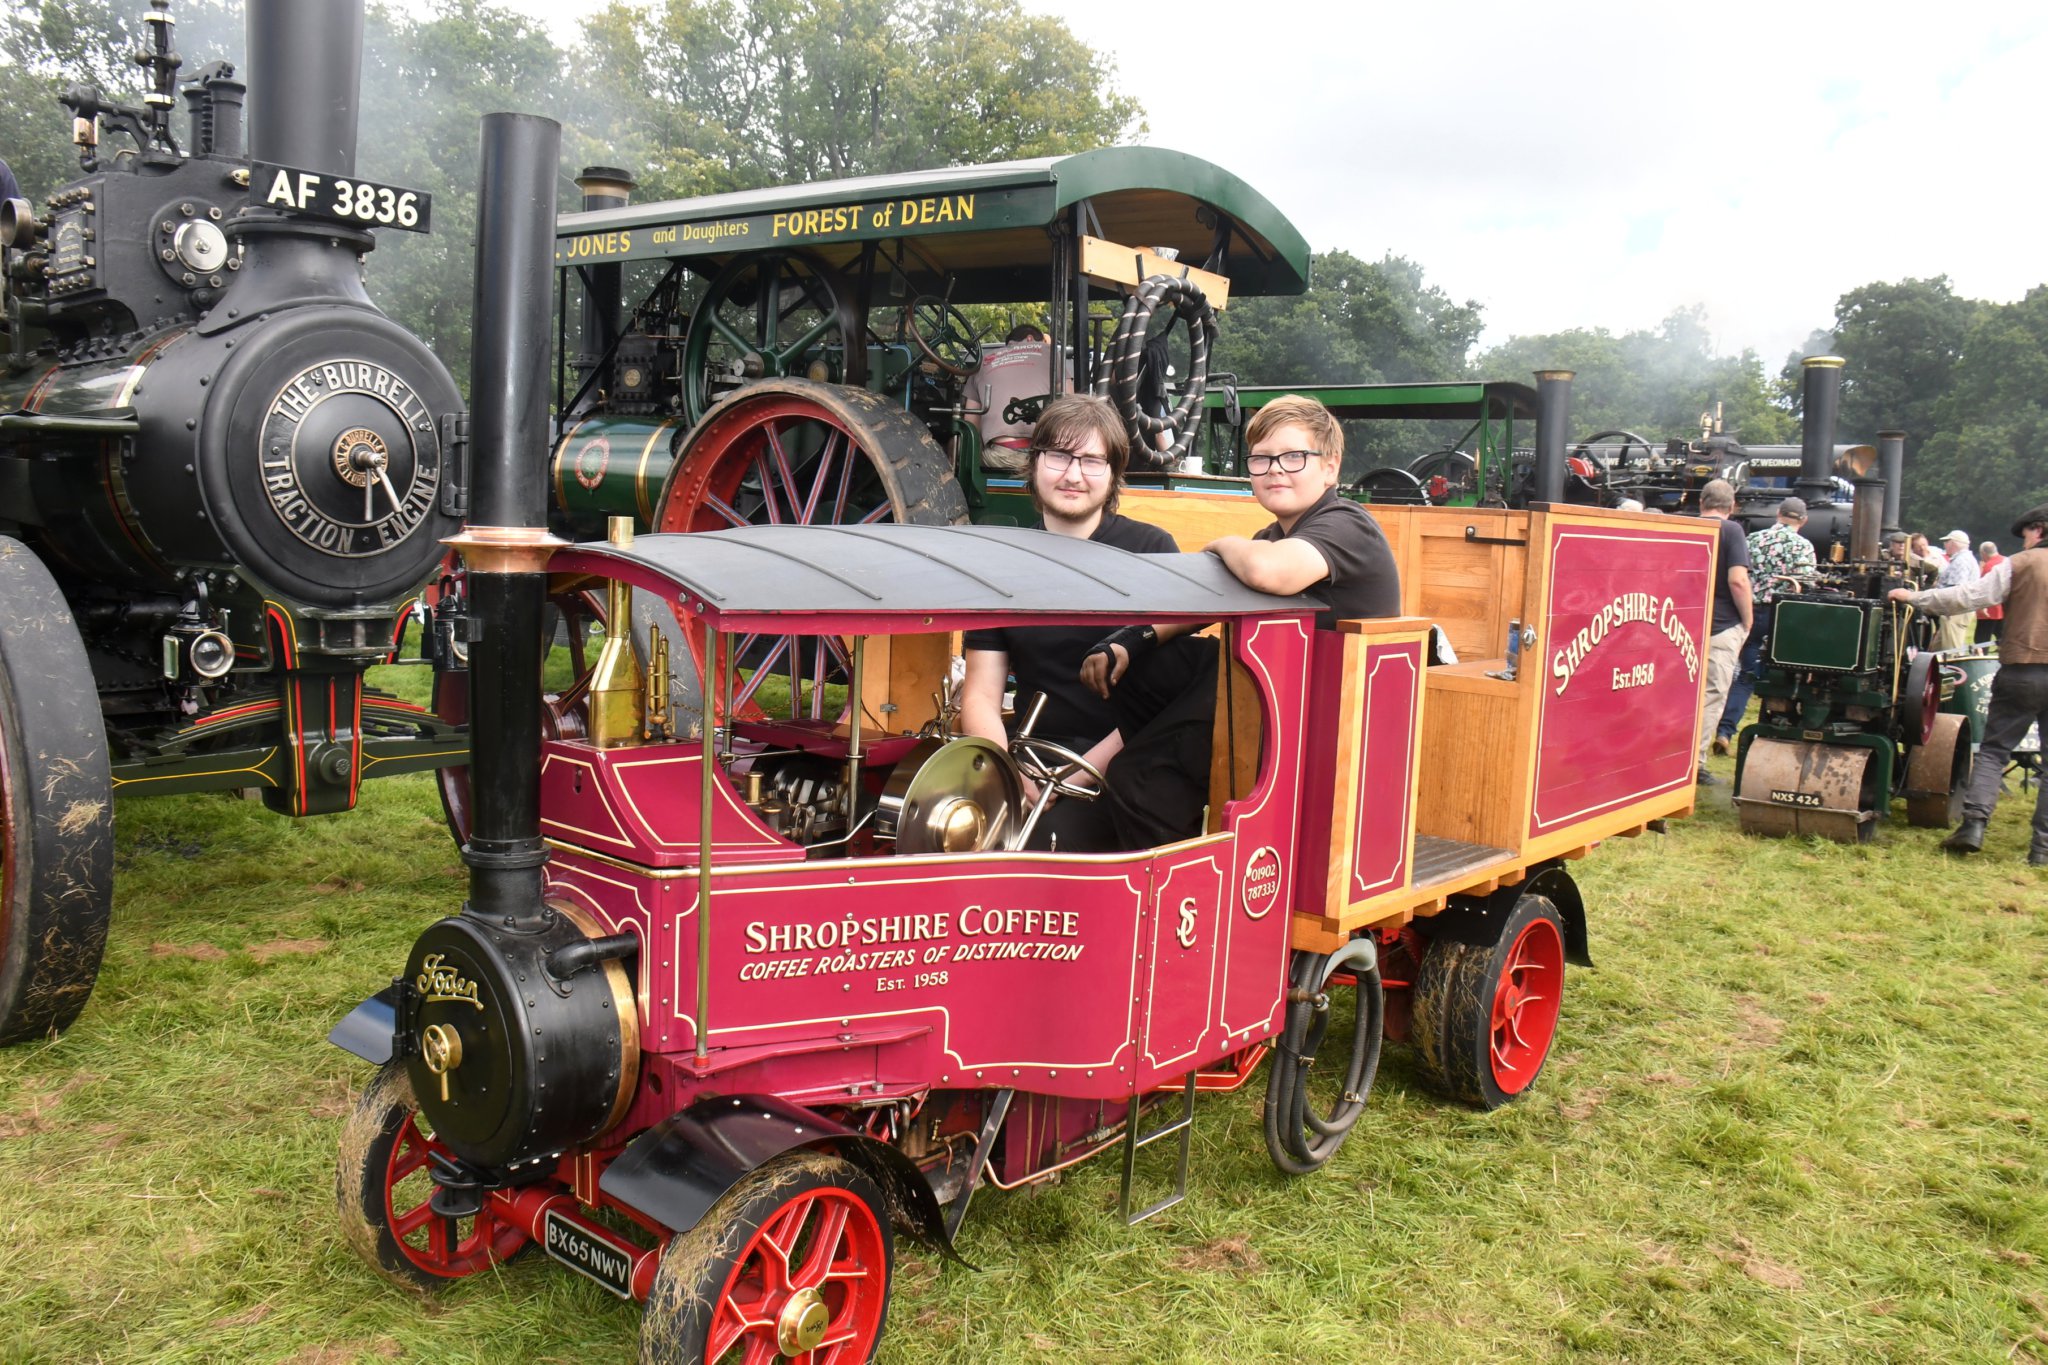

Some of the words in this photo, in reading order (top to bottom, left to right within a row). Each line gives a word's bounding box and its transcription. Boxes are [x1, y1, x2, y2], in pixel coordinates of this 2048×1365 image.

[267, 170, 320, 209] AF
[333, 181, 418, 226] 3836
[568, 231, 631, 258] JONES
[653, 227, 676, 244] and
[683, 219, 749, 245] Daughters
[773, 205, 864, 238] FOREST
[872, 203, 895, 228] of
[901, 194, 975, 226] DEAN
[272, 376, 320, 423] THE
[264, 455, 355, 554] TRACTION
[377, 464, 438, 549] ENGINE
[1553, 592, 1658, 696] SHROPSHIRE
[1660, 597, 1700, 683] COFFEE
[1772, 792, 1794, 802] NXS
[1796, 795, 1819, 806] 424
[1247, 881, 1276, 901] 787333
[1251, 864, 1276, 882] 01902
[745, 912, 950, 954] SHROPSHIRE
[959, 904, 1080, 938] COFFEE
[416, 953, 484, 1011] Foden
[739, 957, 812, 982] COFFEE
[814, 948, 916, 975] ROASTERS
[923, 946, 949, 965] OF
[951, 941, 1084, 963] DISTINCTION
[914, 971, 950, 989] 1958
